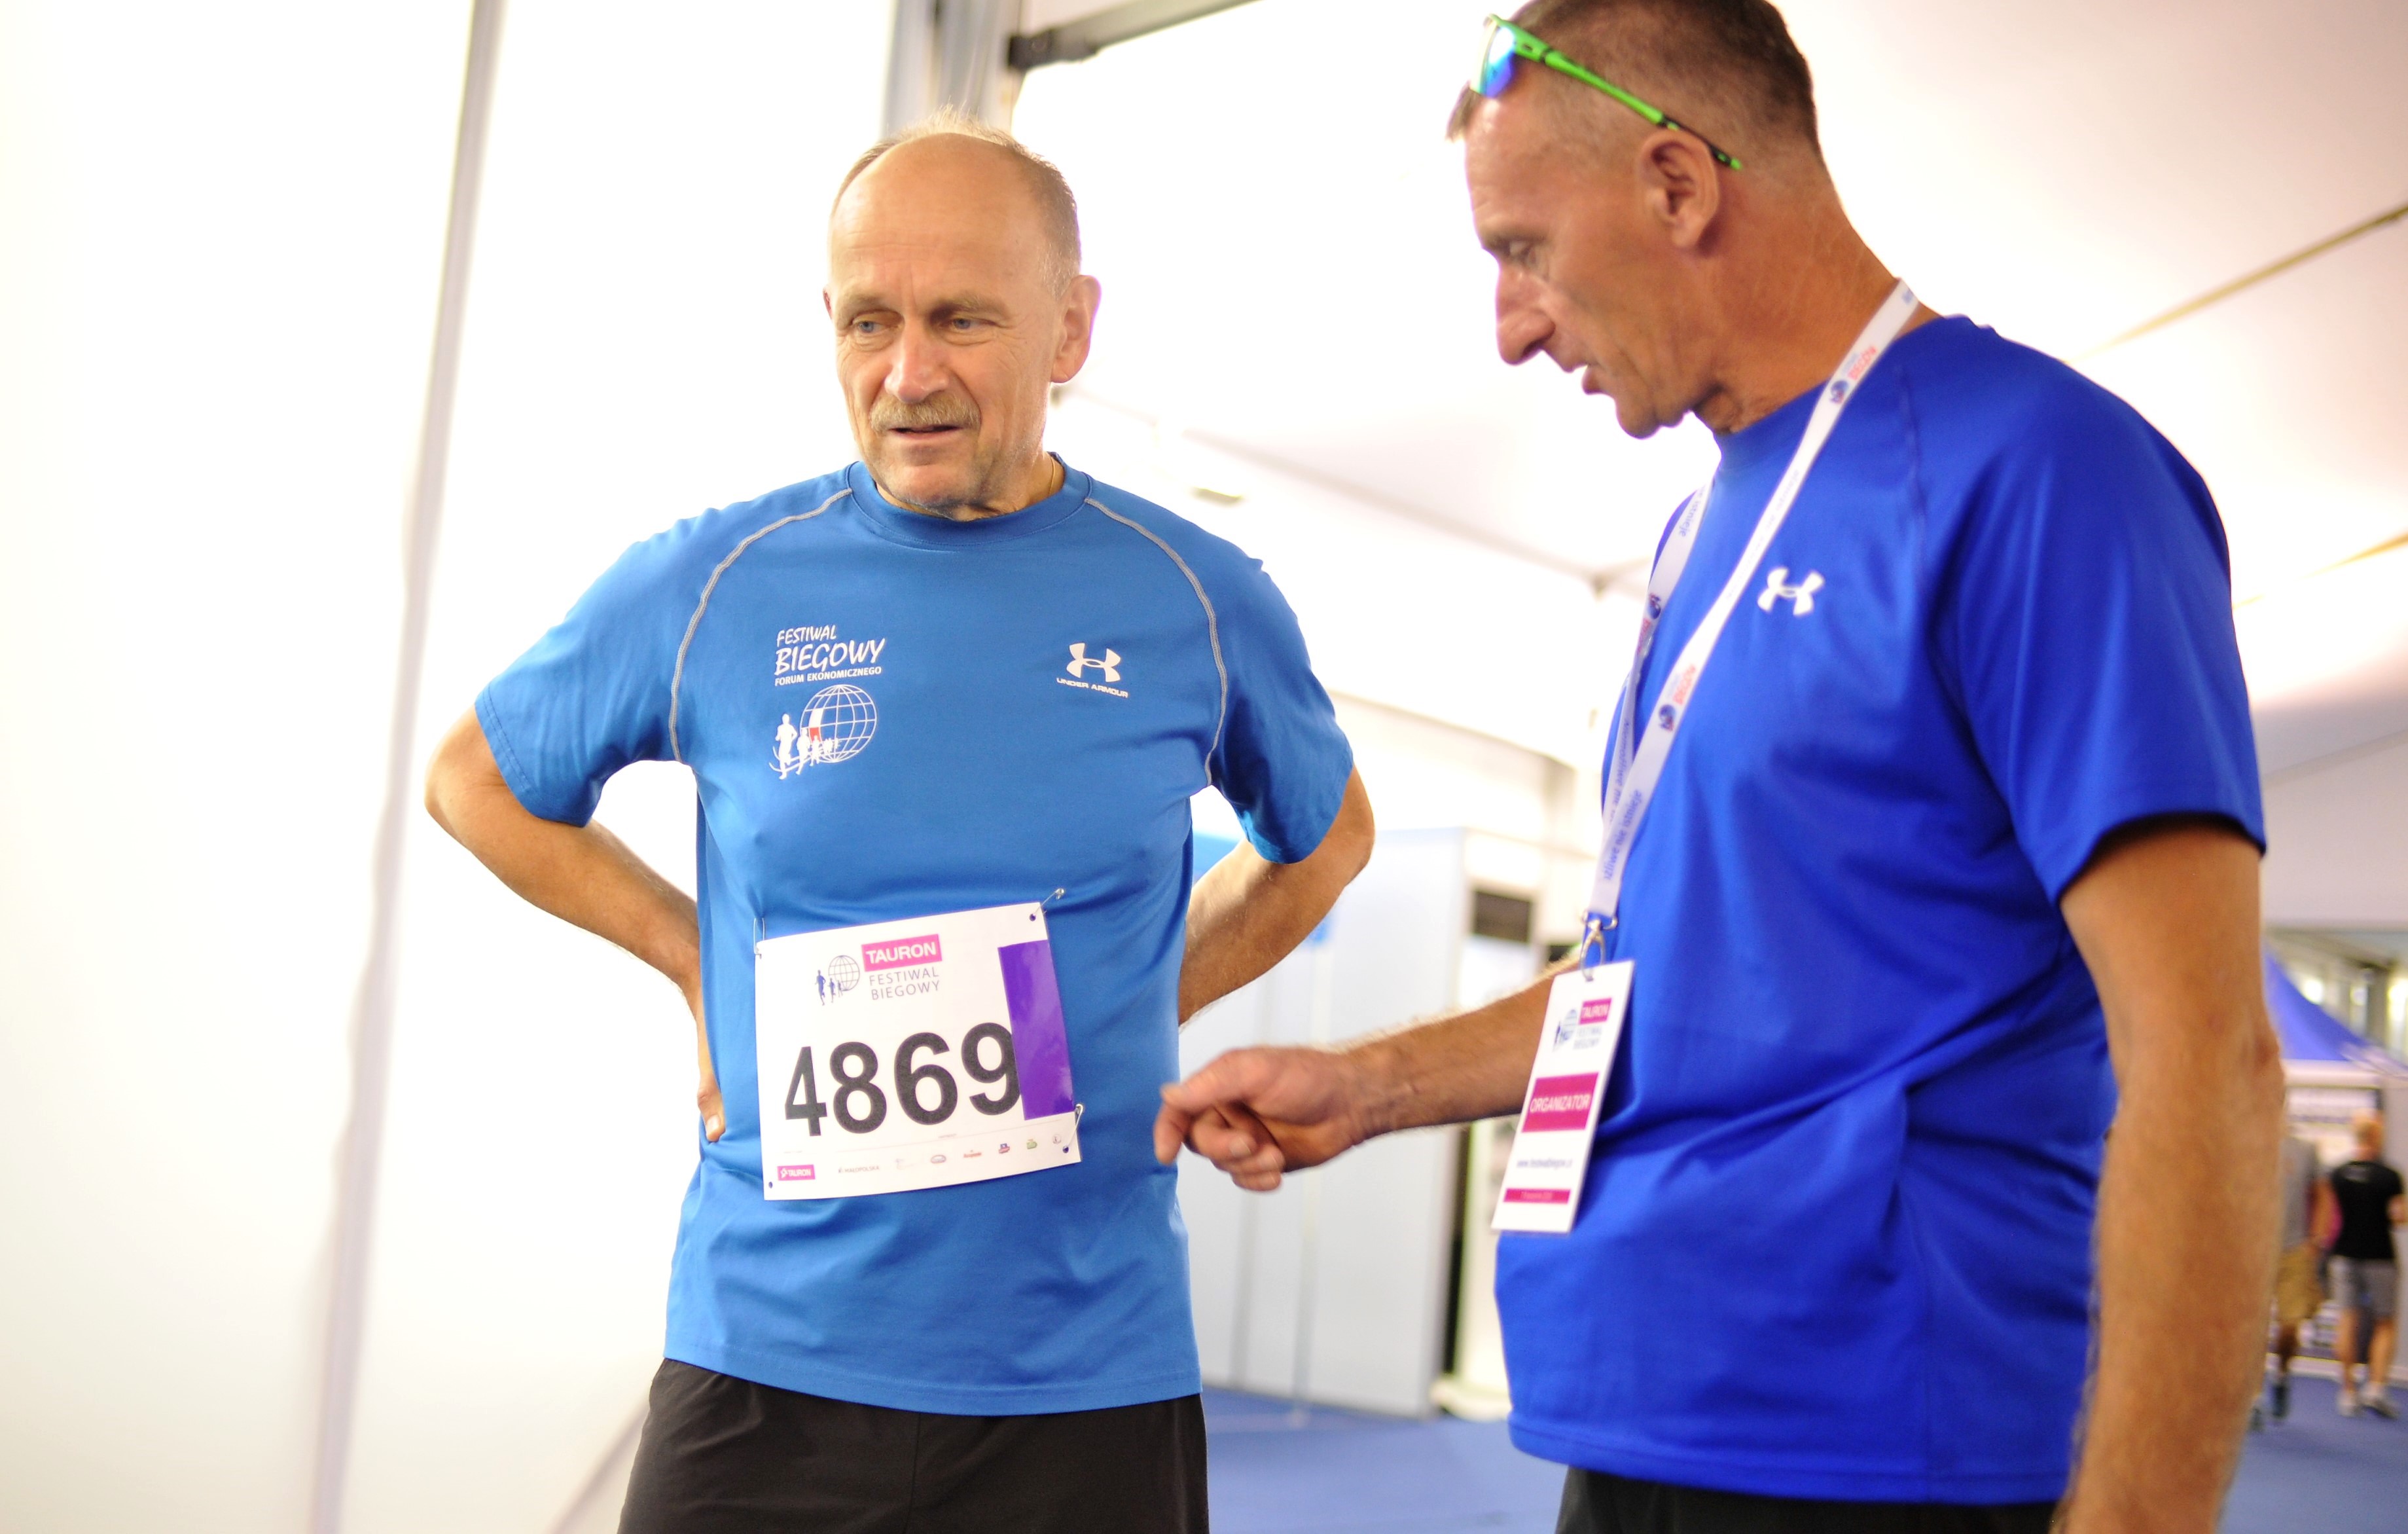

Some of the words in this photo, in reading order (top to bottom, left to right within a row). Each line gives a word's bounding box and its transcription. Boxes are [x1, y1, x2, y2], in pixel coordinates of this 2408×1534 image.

[776, 625, 837, 648] FESTIWAL
[774, 638, 886, 676] BIEGOWY
[774, 674, 804, 687] FORUM
[806, 666, 882, 682] EKONOMICZNEGO
[1056, 677, 1089, 689] UNDER
[1091, 684, 1128, 699] ARMOUR
[865, 941, 937, 964] TAURON
[869, 966, 939, 986] FESTIWAL
[871, 979, 940, 1000] BIEGOWY
[1581, 1004, 1610, 1018] TAURON
[785, 1021, 1022, 1137] 4869
[1530, 1094, 1591, 1113] ORGANIZATOR
[787, 1168, 812, 1177] TAURON
